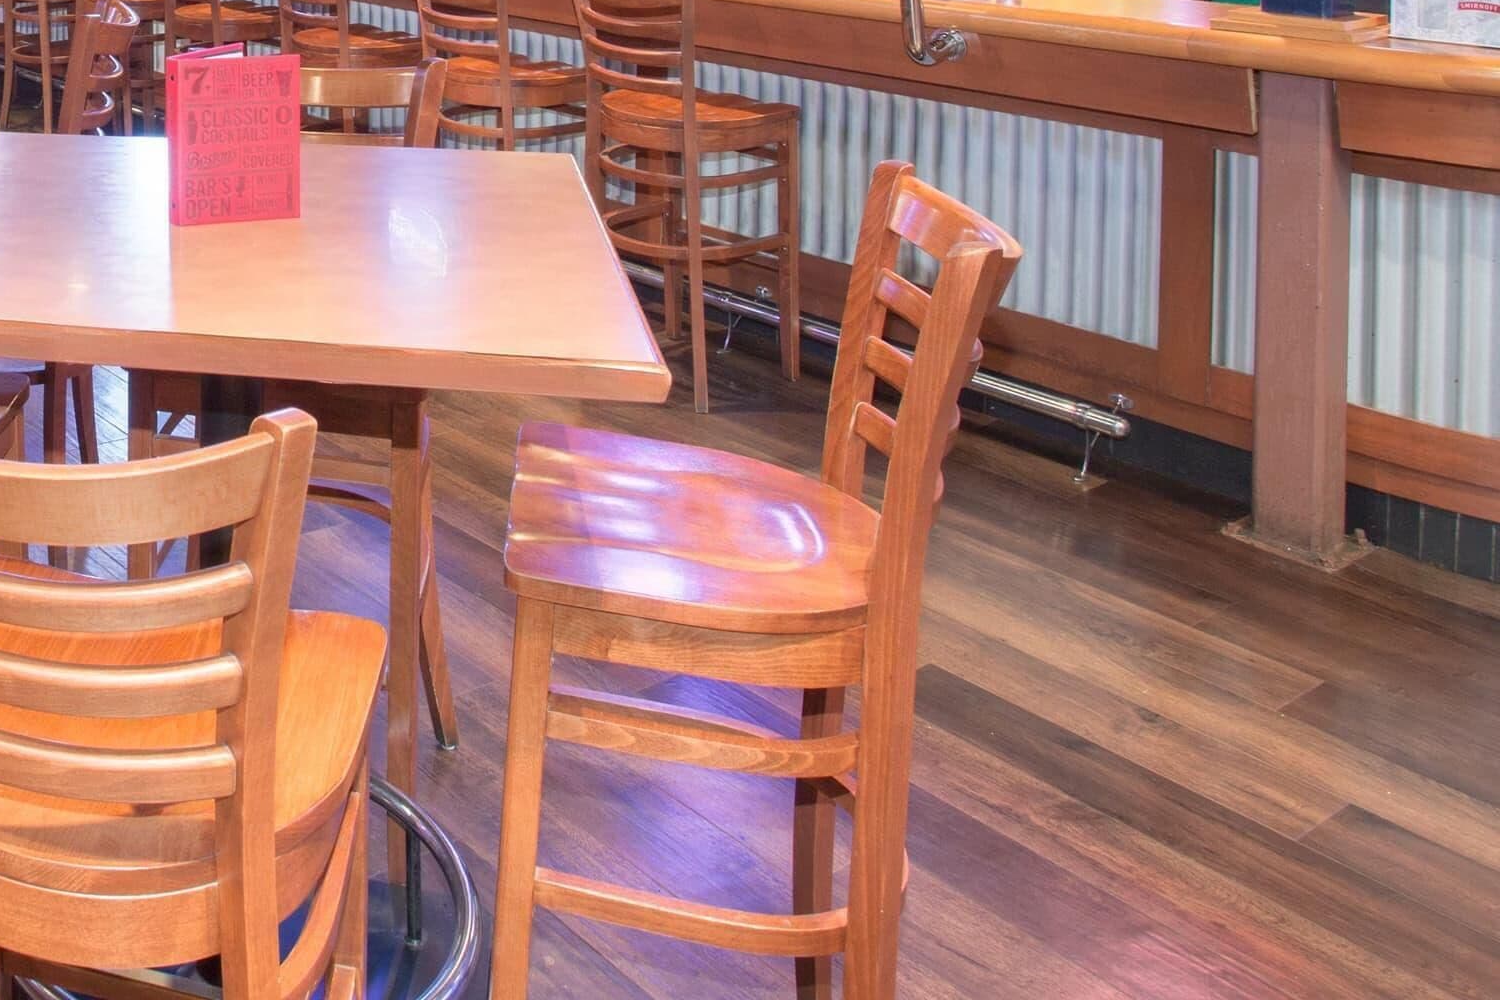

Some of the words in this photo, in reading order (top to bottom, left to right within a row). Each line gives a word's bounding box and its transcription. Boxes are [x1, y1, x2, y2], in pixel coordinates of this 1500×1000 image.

[201, 106, 269, 129] CLASSIC
[185, 177, 231, 198] BAR'S
[185, 196, 232, 219] OPEN
